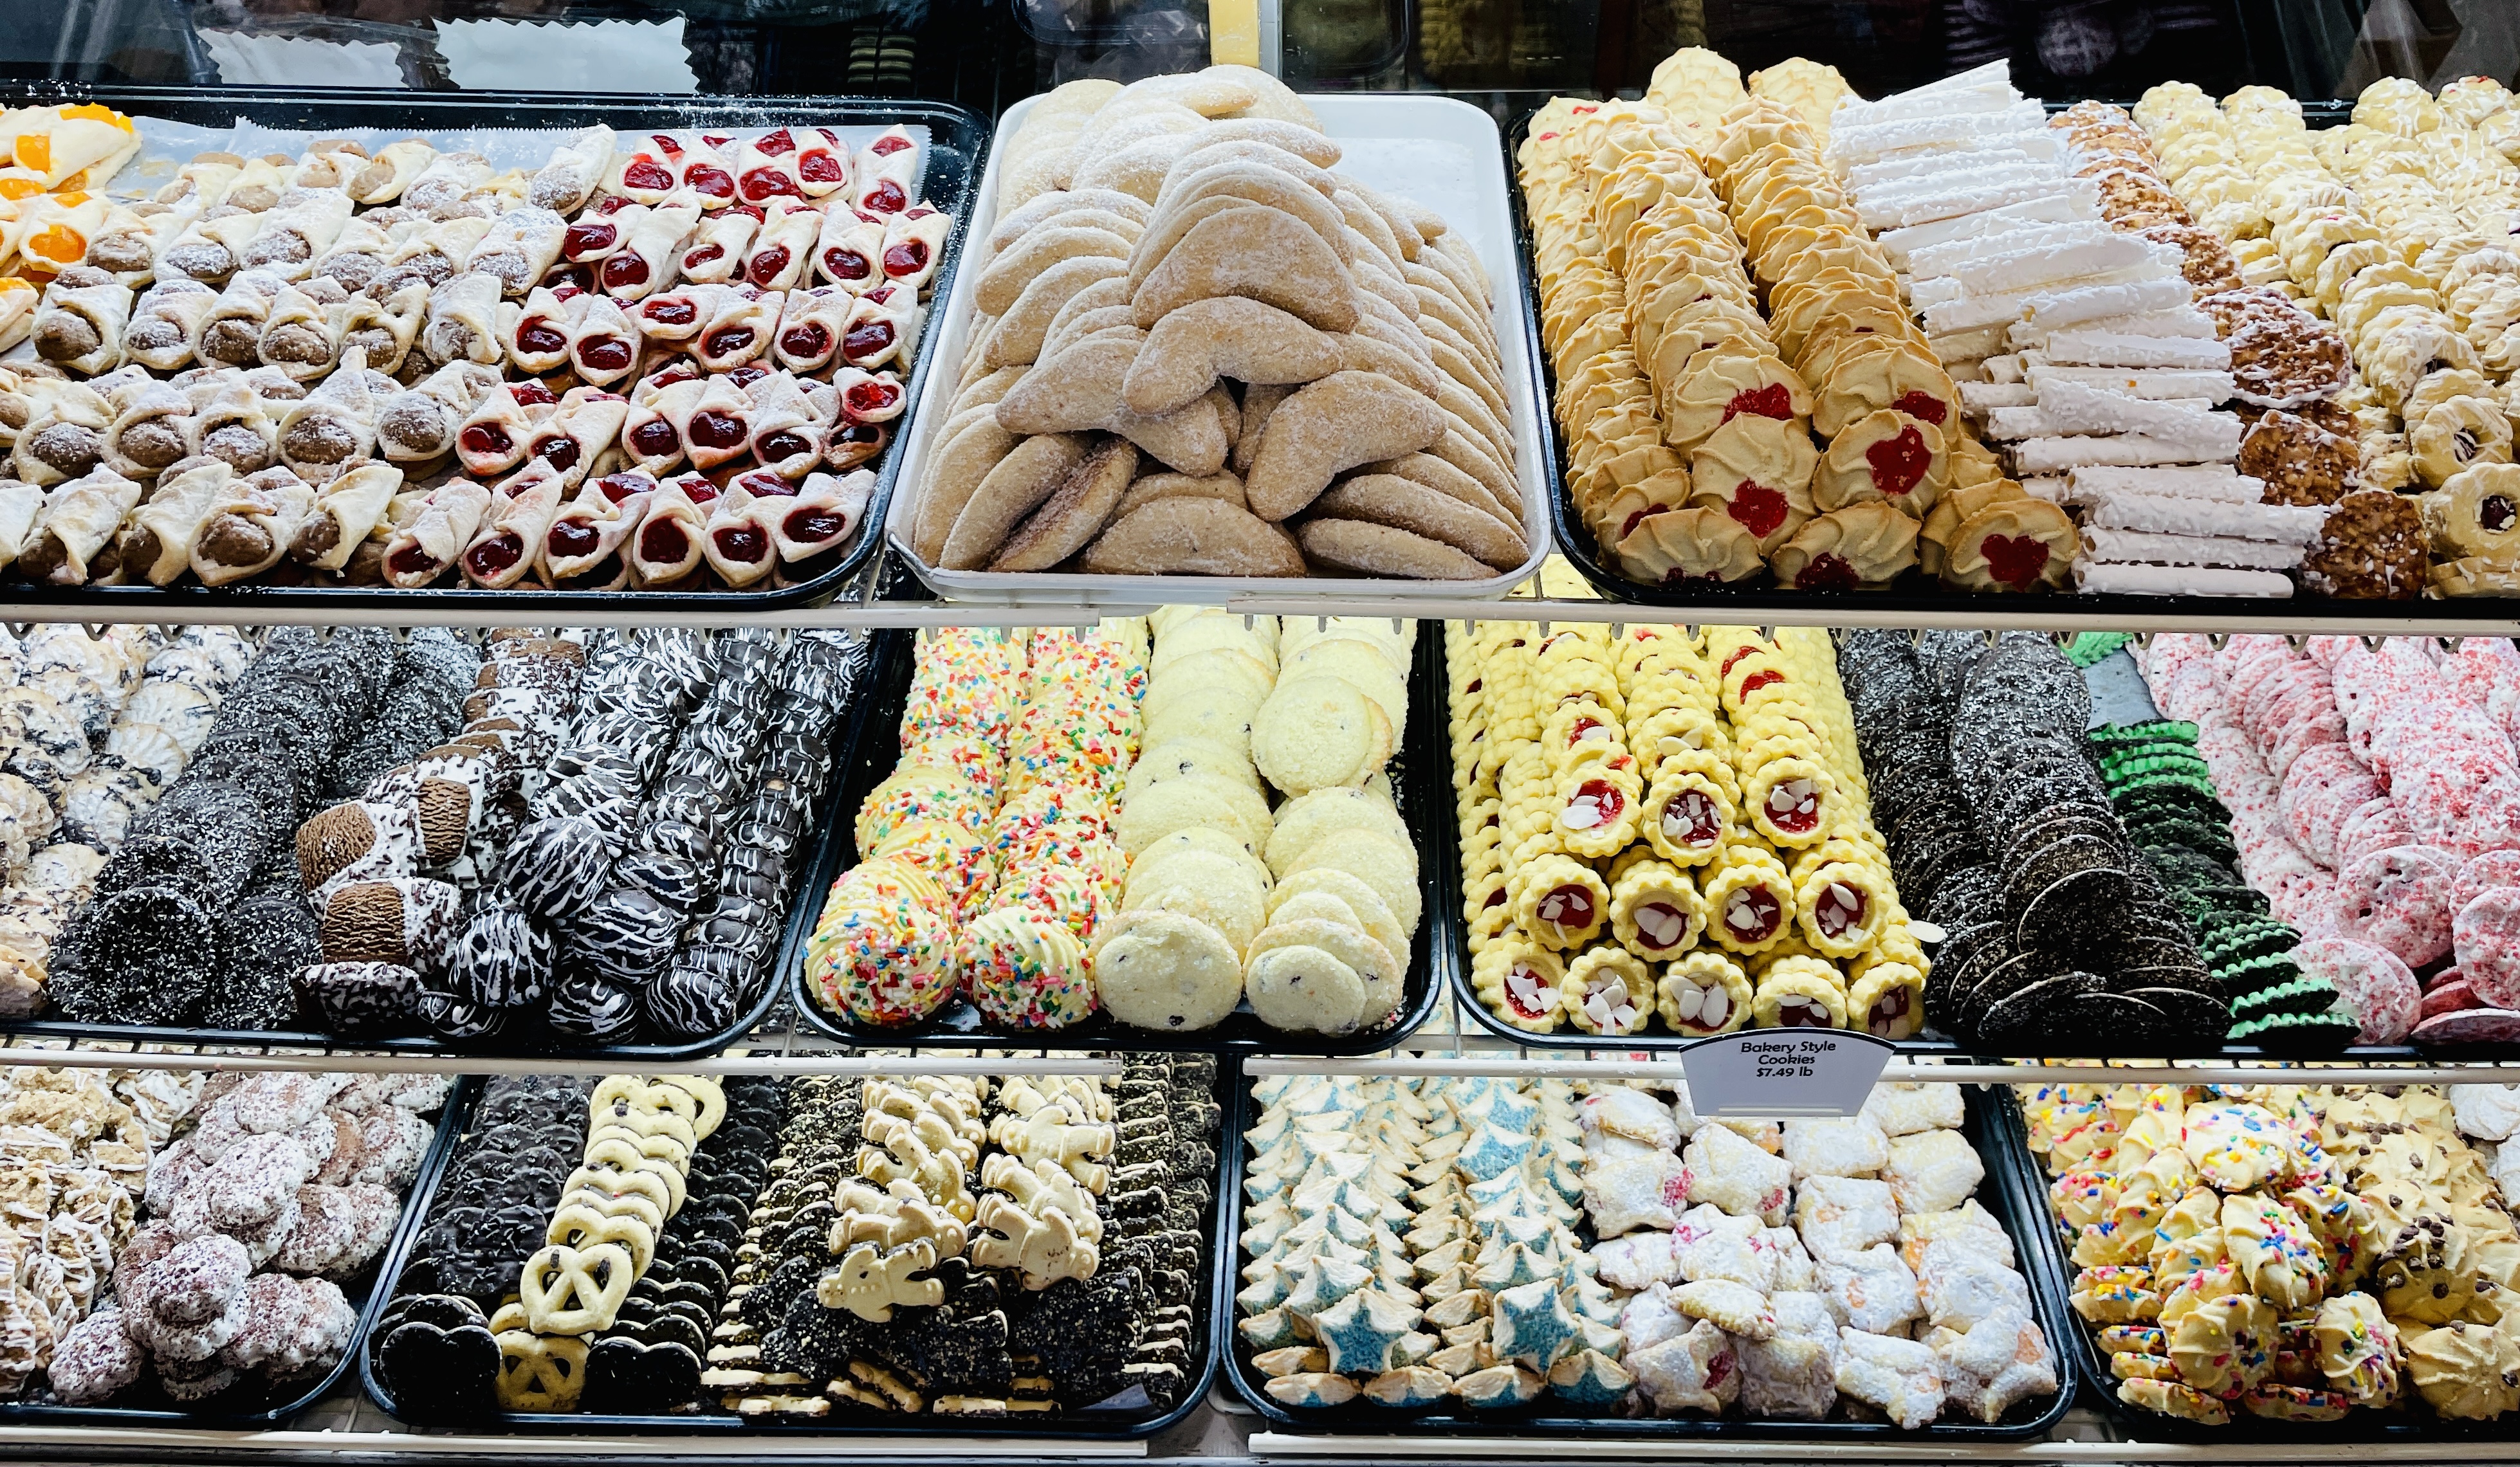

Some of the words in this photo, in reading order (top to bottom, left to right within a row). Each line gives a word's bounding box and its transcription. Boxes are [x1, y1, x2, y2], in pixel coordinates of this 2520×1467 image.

[1741, 1041, 1796, 1053] Bakery
[1800, 1041, 1836, 1053] Style
[1758, 1054, 1815, 1065] Cookies
[1756, 1067, 1794, 1077] $7.49
[1799, 1066, 1813, 1077] lb
